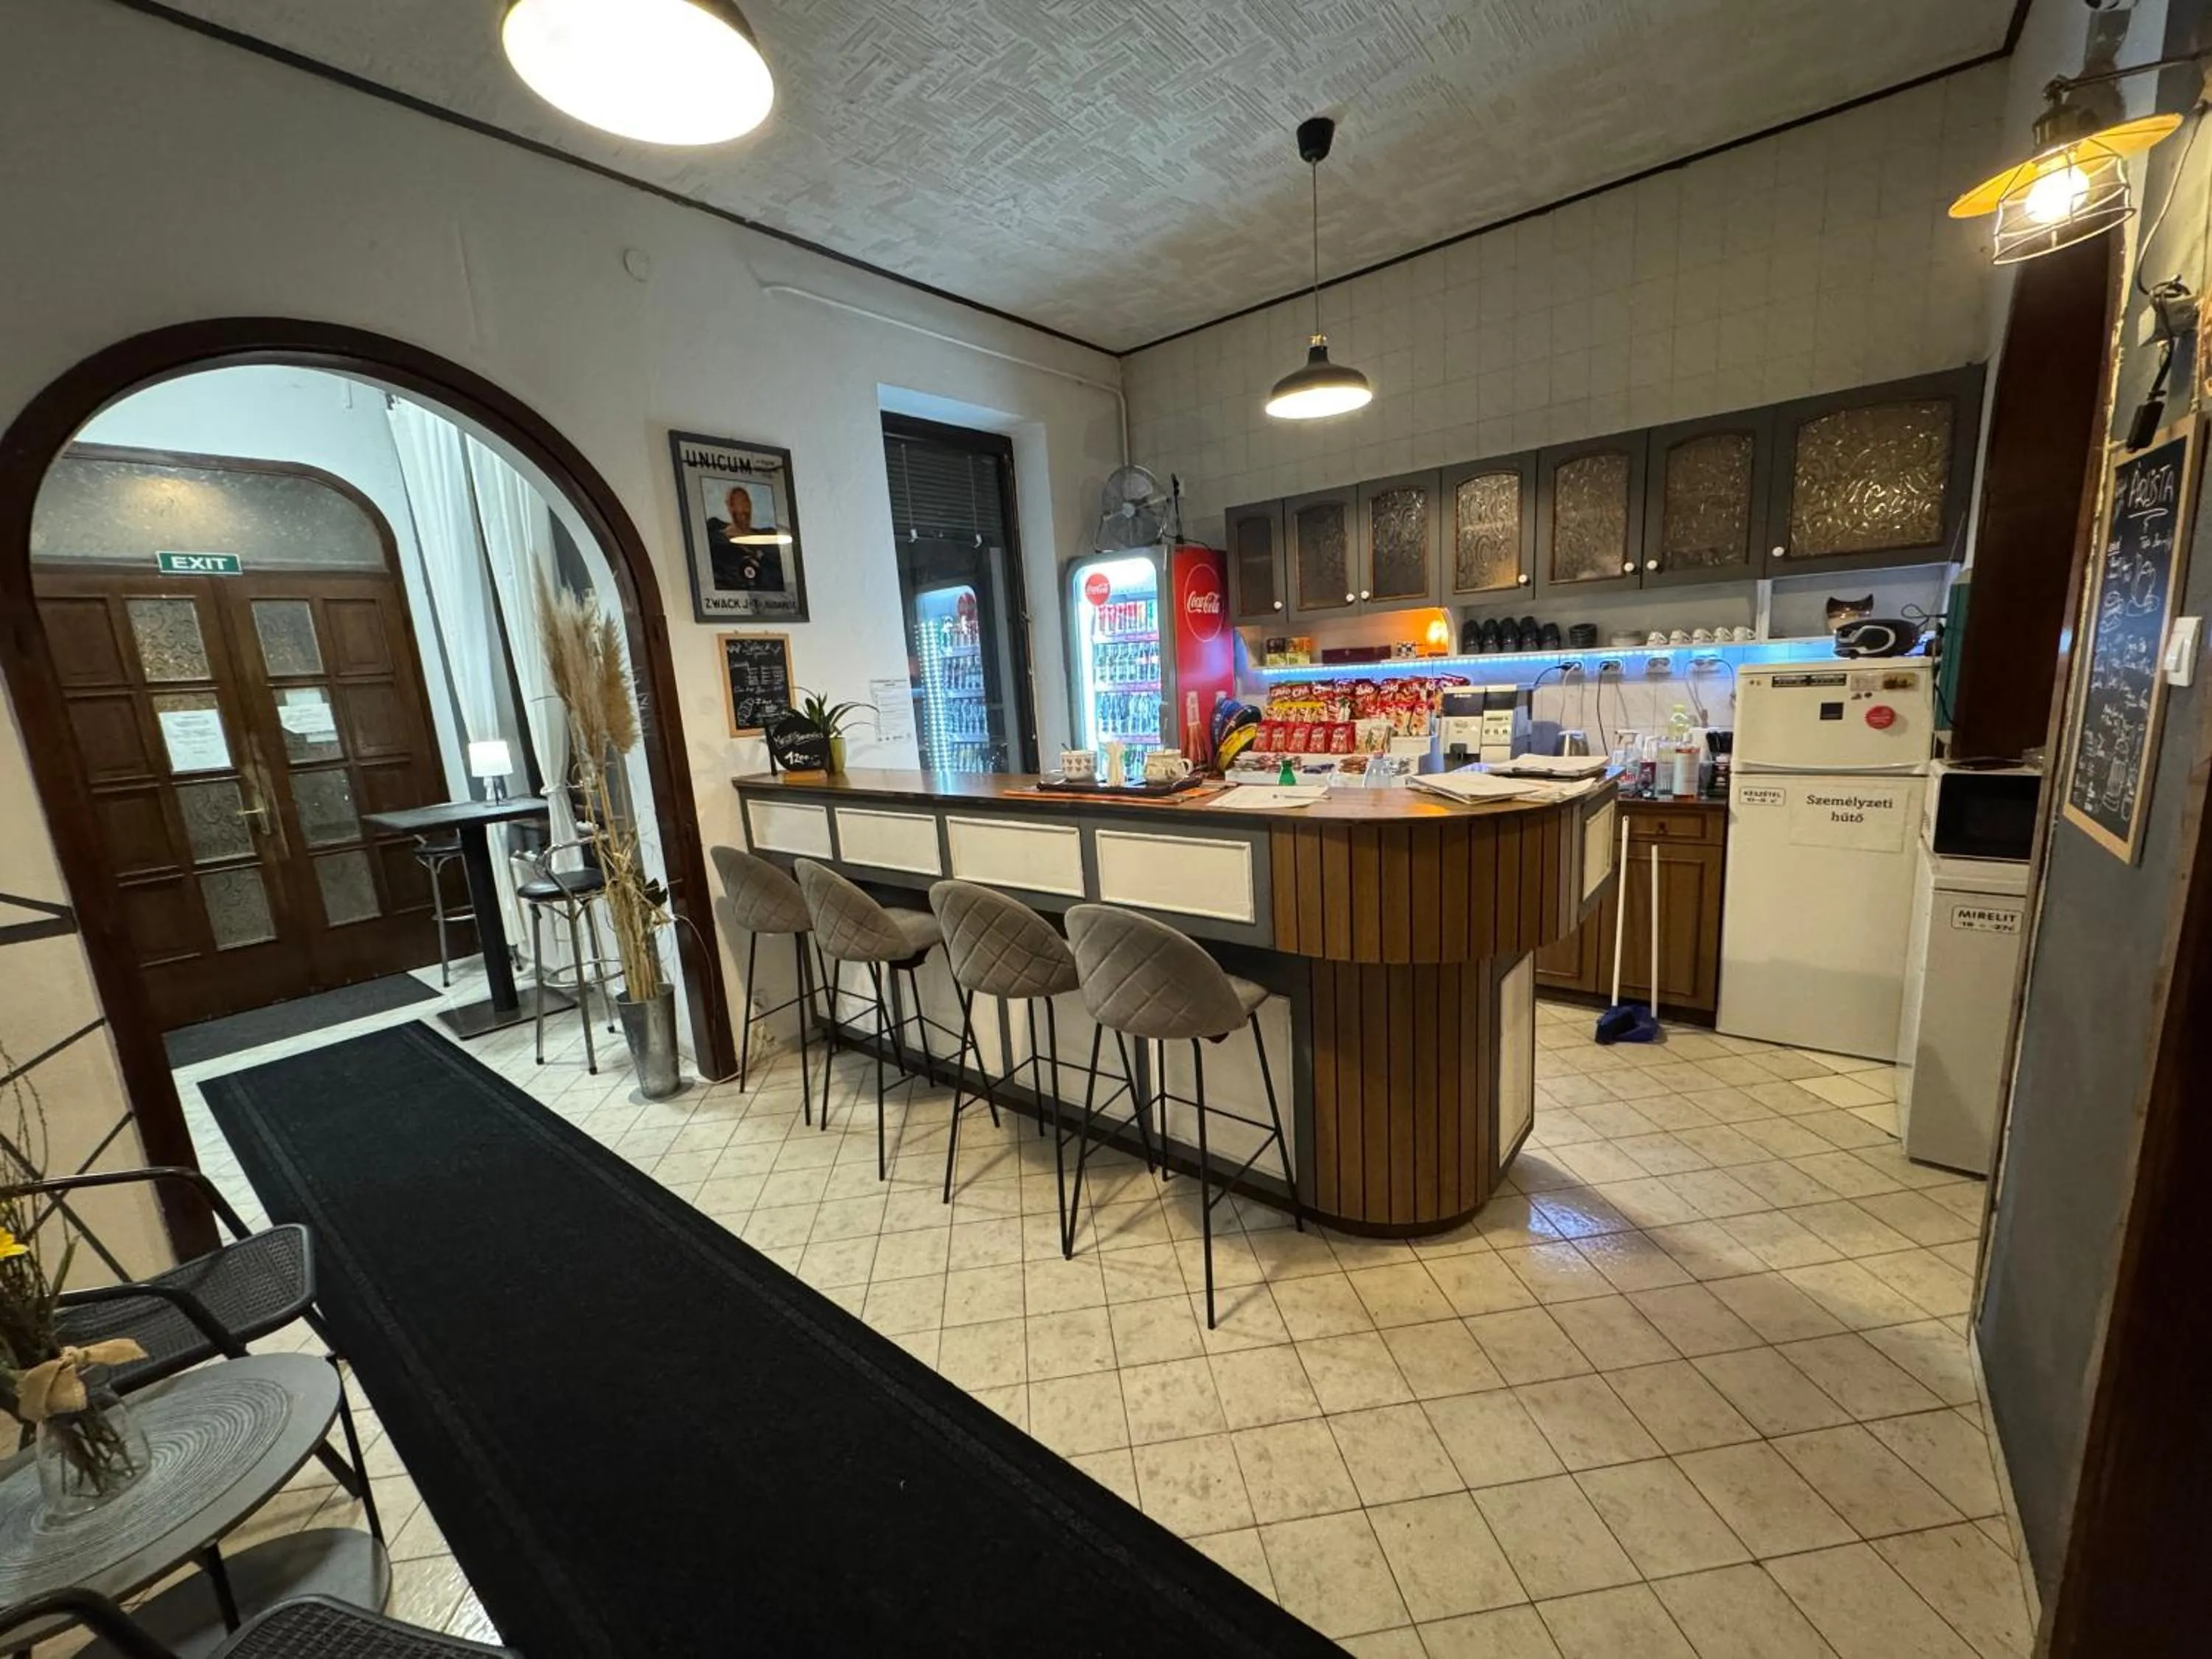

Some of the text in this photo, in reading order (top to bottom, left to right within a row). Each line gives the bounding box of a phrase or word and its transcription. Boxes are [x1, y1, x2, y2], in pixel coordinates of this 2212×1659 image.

[686, 449, 752, 476] UNICUM
[170, 555, 228, 570] EXIT
[1806, 794, 1893, 810] Személyzeti
[1831, 811, 1864, 824] hűtő
[1958, 910, 2016, 922] MIRELIT
